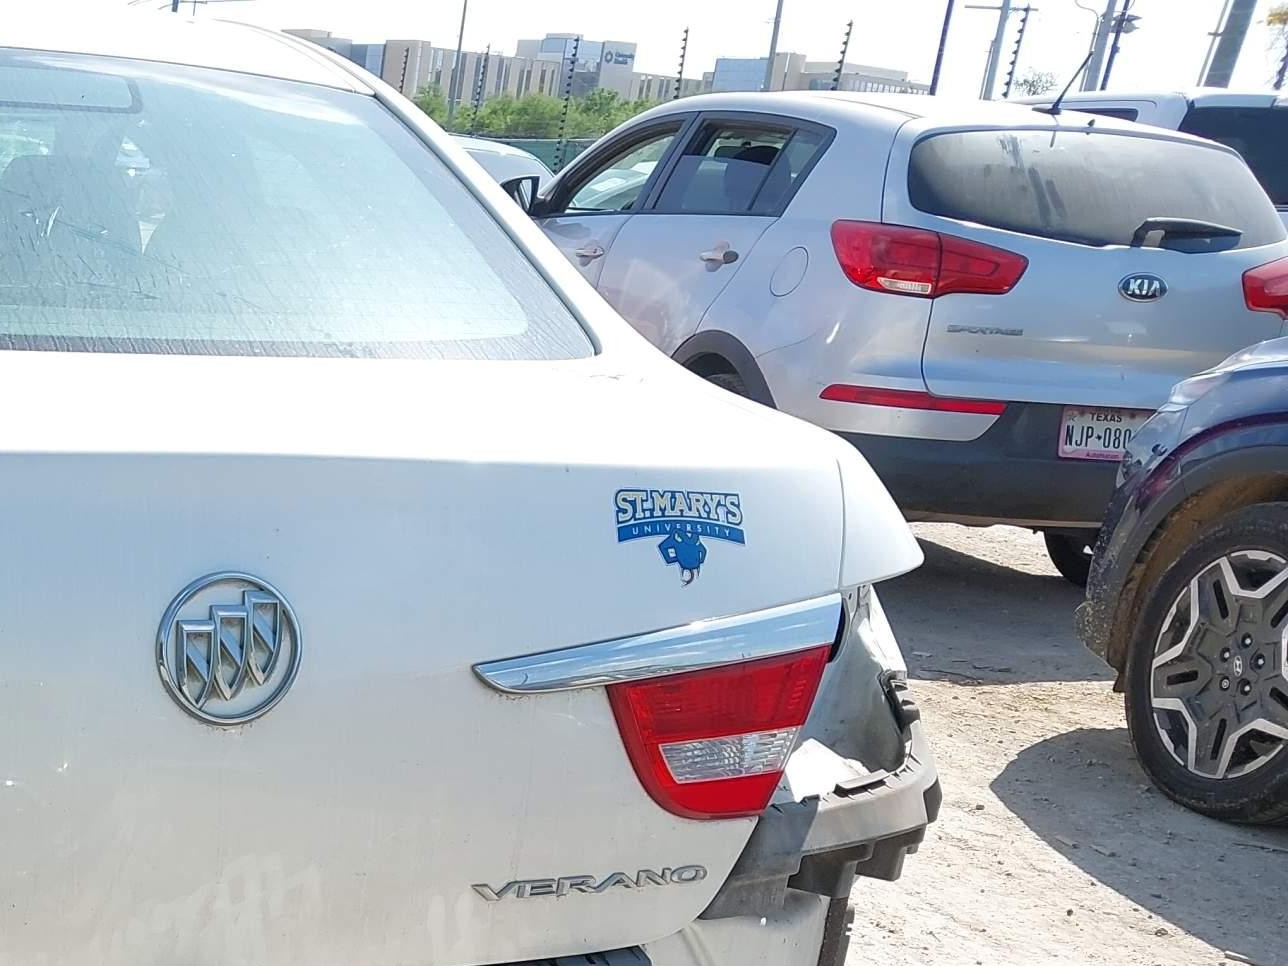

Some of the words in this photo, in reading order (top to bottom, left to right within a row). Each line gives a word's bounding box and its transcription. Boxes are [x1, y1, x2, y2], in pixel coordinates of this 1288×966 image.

[1127, 278, 1161, 297] KIA
[1090, 412, 1122, 423] TEXAS
[632, 522, 730, 538] UNIVERSITY
[471, 865, 708, 902] VERANO
